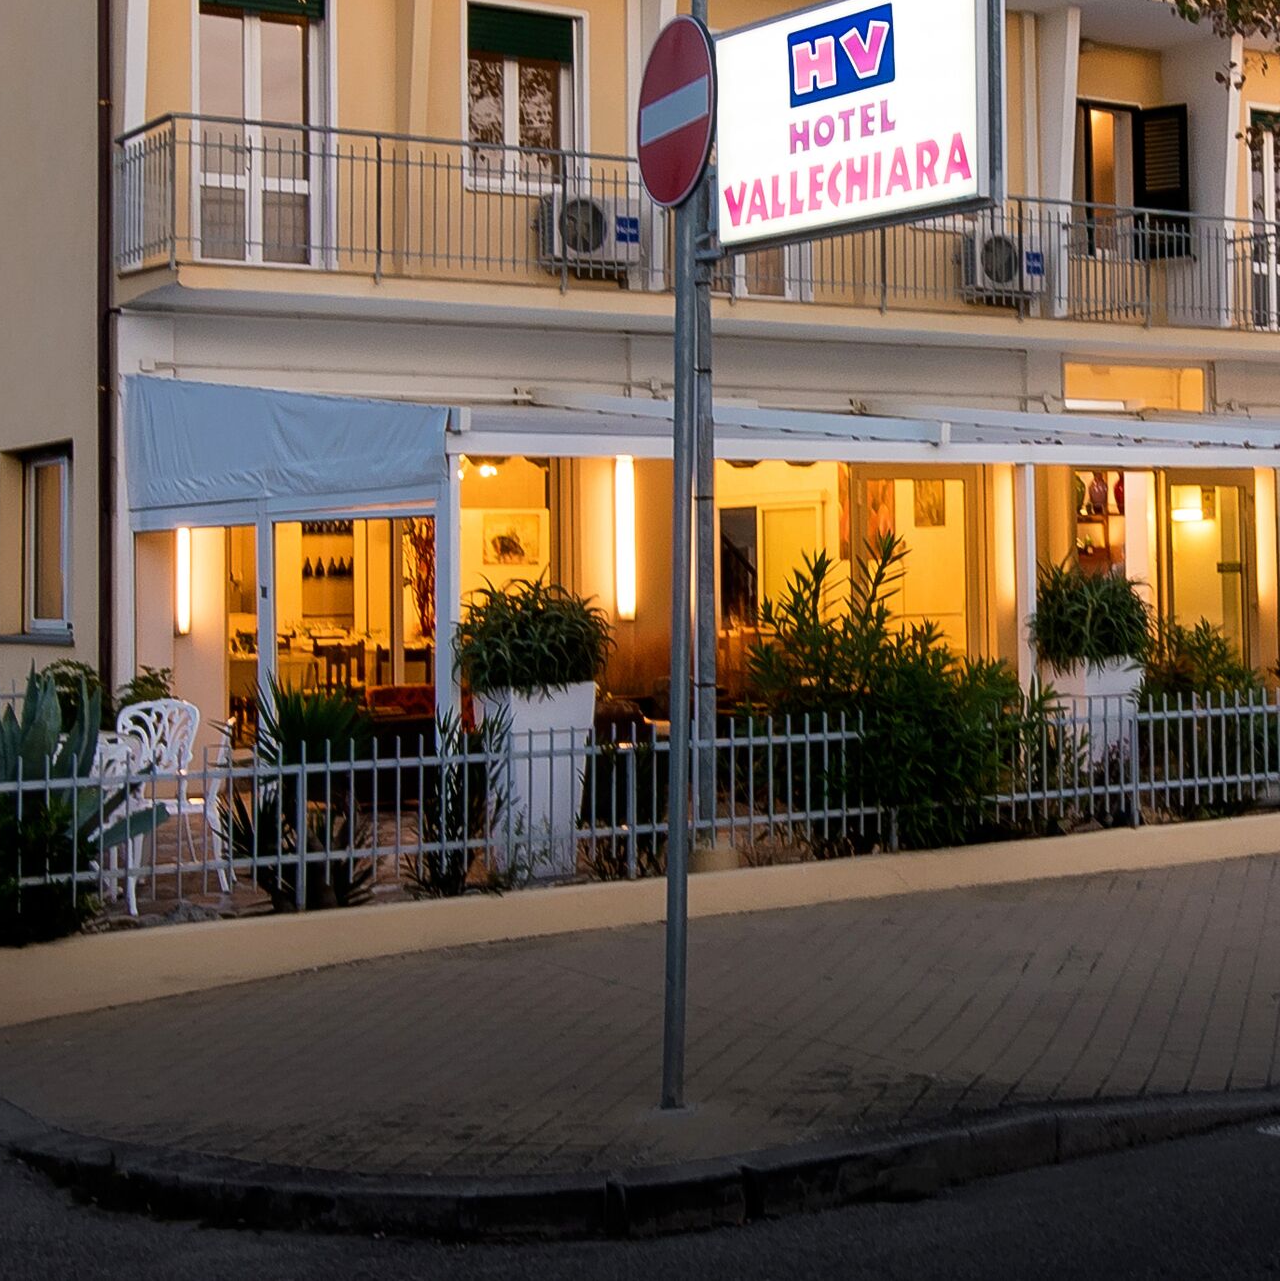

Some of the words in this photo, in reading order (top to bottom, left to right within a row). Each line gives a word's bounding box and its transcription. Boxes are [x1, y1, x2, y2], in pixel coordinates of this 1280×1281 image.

[792, 20, 890, 95] HV
[789, 99, 896, 155] HOTEL
[723, 132, 972, 227] VALLECHIARA
